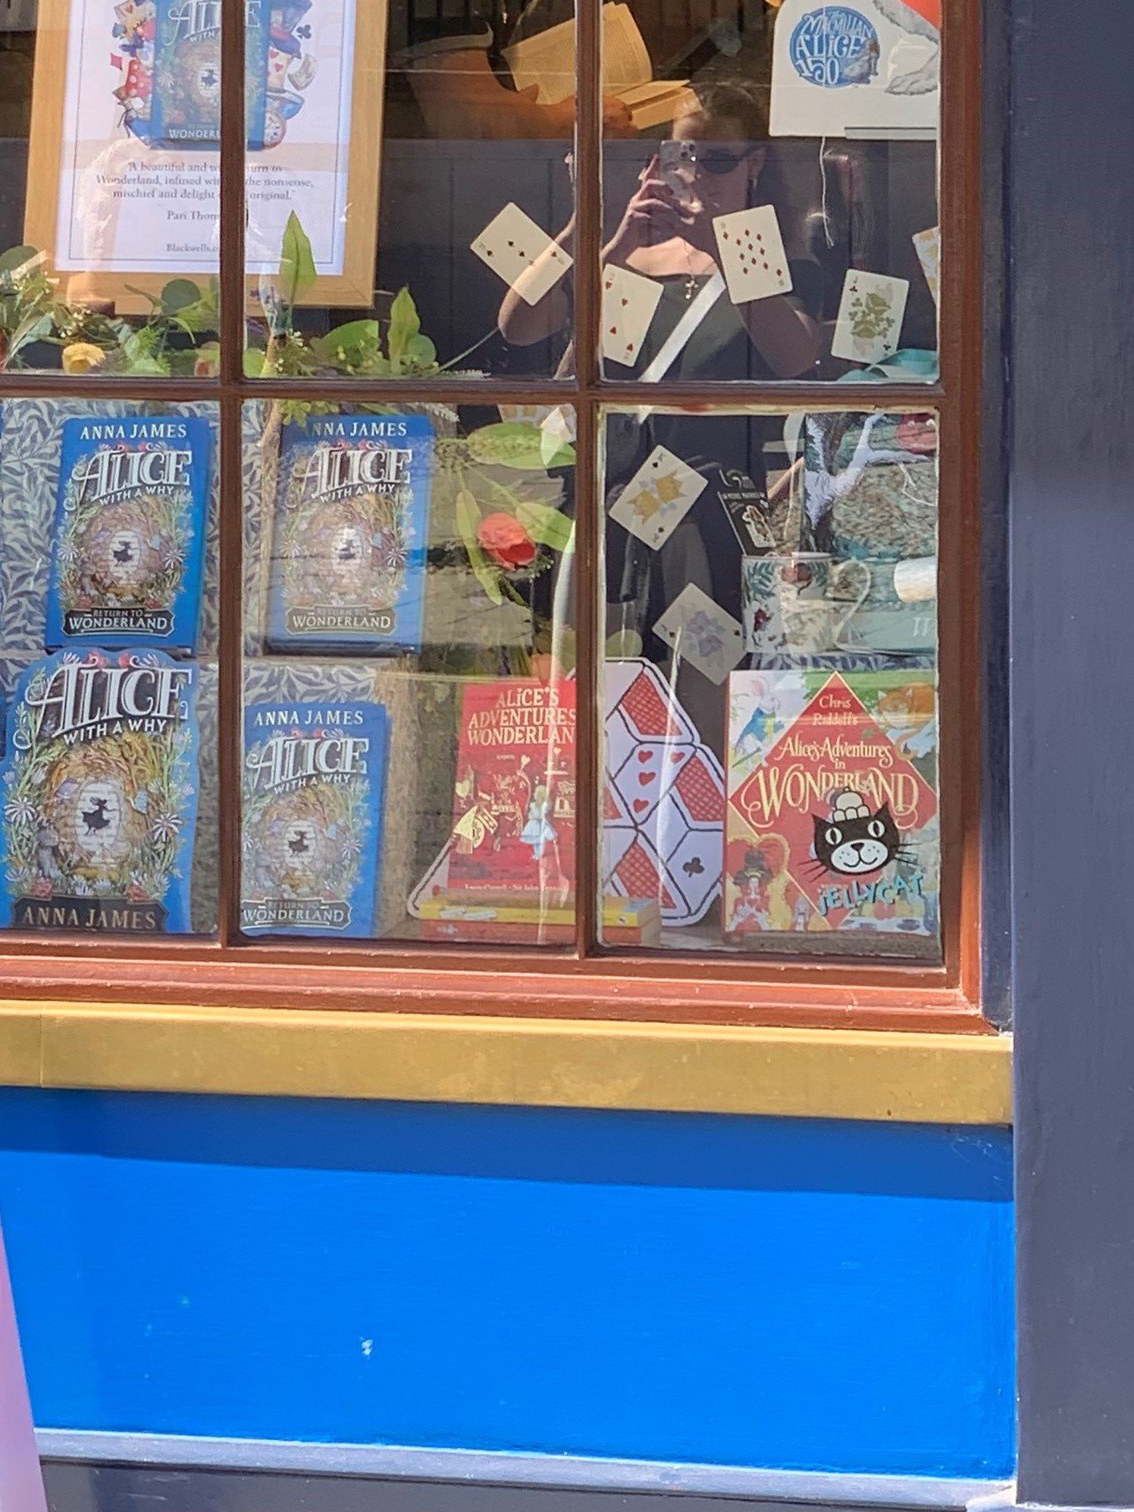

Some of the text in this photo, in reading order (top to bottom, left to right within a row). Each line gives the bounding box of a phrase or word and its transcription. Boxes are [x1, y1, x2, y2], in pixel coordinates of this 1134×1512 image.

[796, 57, 839, 85] 150
[168, 128, 221, 139] WONDERL
[140, 162, 185, 172] beautiful
[188, 162, 207, 172] and
[96, 175, 163, 187] Wonderland,
[165, 176, 202, 186] infused
[264, 178, 314, 188] nonsense,
[113, 189, 156, 199] mischief
[158, 190, 178, 199] and
[180, 190, 216, 201] delight
[80, 423, 188, 440] ANNA JAMES
[307, 422, 407, 437] NNA JAMES
[71, 446, 193, 505] ALICE
[292, 444, 413, 499] ALICE
[99, 485, 175, 506] WITH A WHY
[320, 483, 395, 503] WITH A WHY
[93, 608, 144, 617] RETURN TO
[292, 615, 391, 629] WONDERLAND
[68, 616, 168, 630] WONDERLAND
[25, 658, 192, 738] ALICE
[819, 694, 852, 709] Chris
[255, 710, 364, 726] ANNA JAMES
[468, 708, 577, 729] ADVENTURES
[63, 719, 168, 745] WITH A WHY
[467, 726, 576, 746] WONDERLAN
[774, 731, 894, 769] Alice's Adventures
[246, 735, 370, 791] ALICE
[834, 758, 846, 770] in
[274, 773, 351, 795] WITH A WHY
[740, 763, 919, 829] WONDERLAND
[22, 906, 156, 930] ANNA JAMES
[243, 909, 345, 923] WONDERLAND
